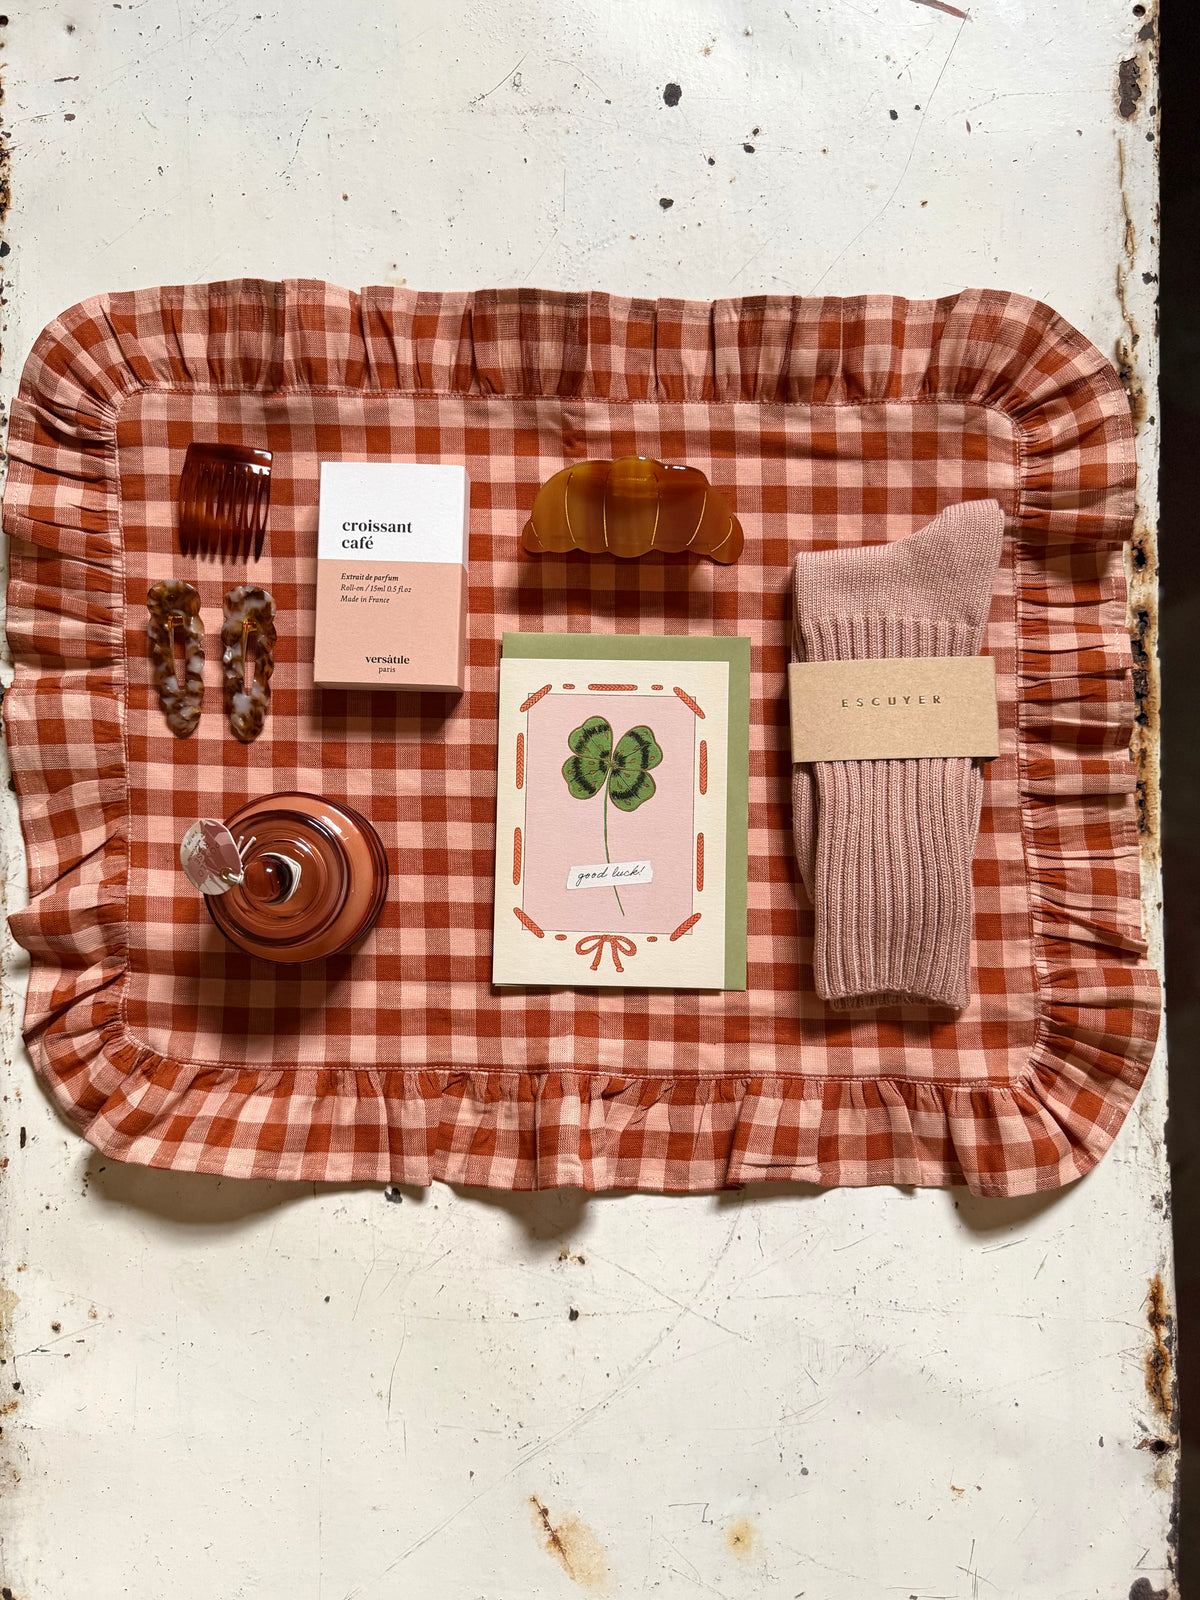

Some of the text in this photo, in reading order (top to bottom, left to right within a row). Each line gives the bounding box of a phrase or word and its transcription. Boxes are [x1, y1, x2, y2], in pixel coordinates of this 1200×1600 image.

[342, 519, 413, 534] croissant
[341, 535, 374, 550] café
[341, 573, 399, 583] Extrait de parfum
[340, 584, 364, 592] Roll-on
[370, 584, 386, 592] 15ml
[386, 585, 397, 593] 0.5
[340, 595, 390, 603] Made in France
[378, 666, 396, 674] paris
[841, 695, 942, 708] ESCUYER
[576, 864, 646, 887] good luck!
